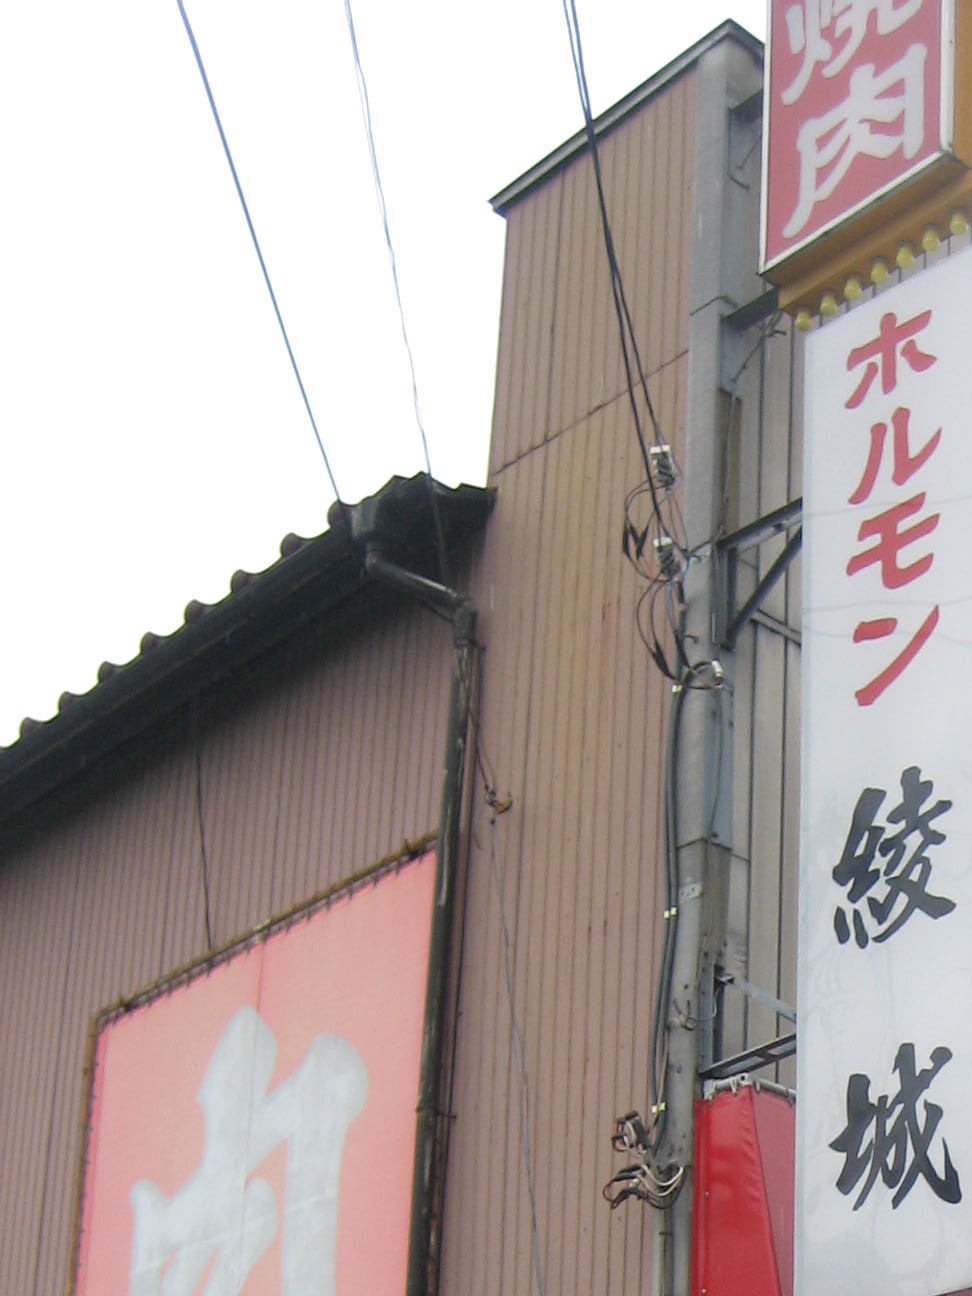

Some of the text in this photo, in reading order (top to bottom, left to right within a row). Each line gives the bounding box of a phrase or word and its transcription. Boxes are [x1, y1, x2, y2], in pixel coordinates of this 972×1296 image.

[844, 309, 942, 706] ホルモン
[829, 766, 962, 1211] 綾城
